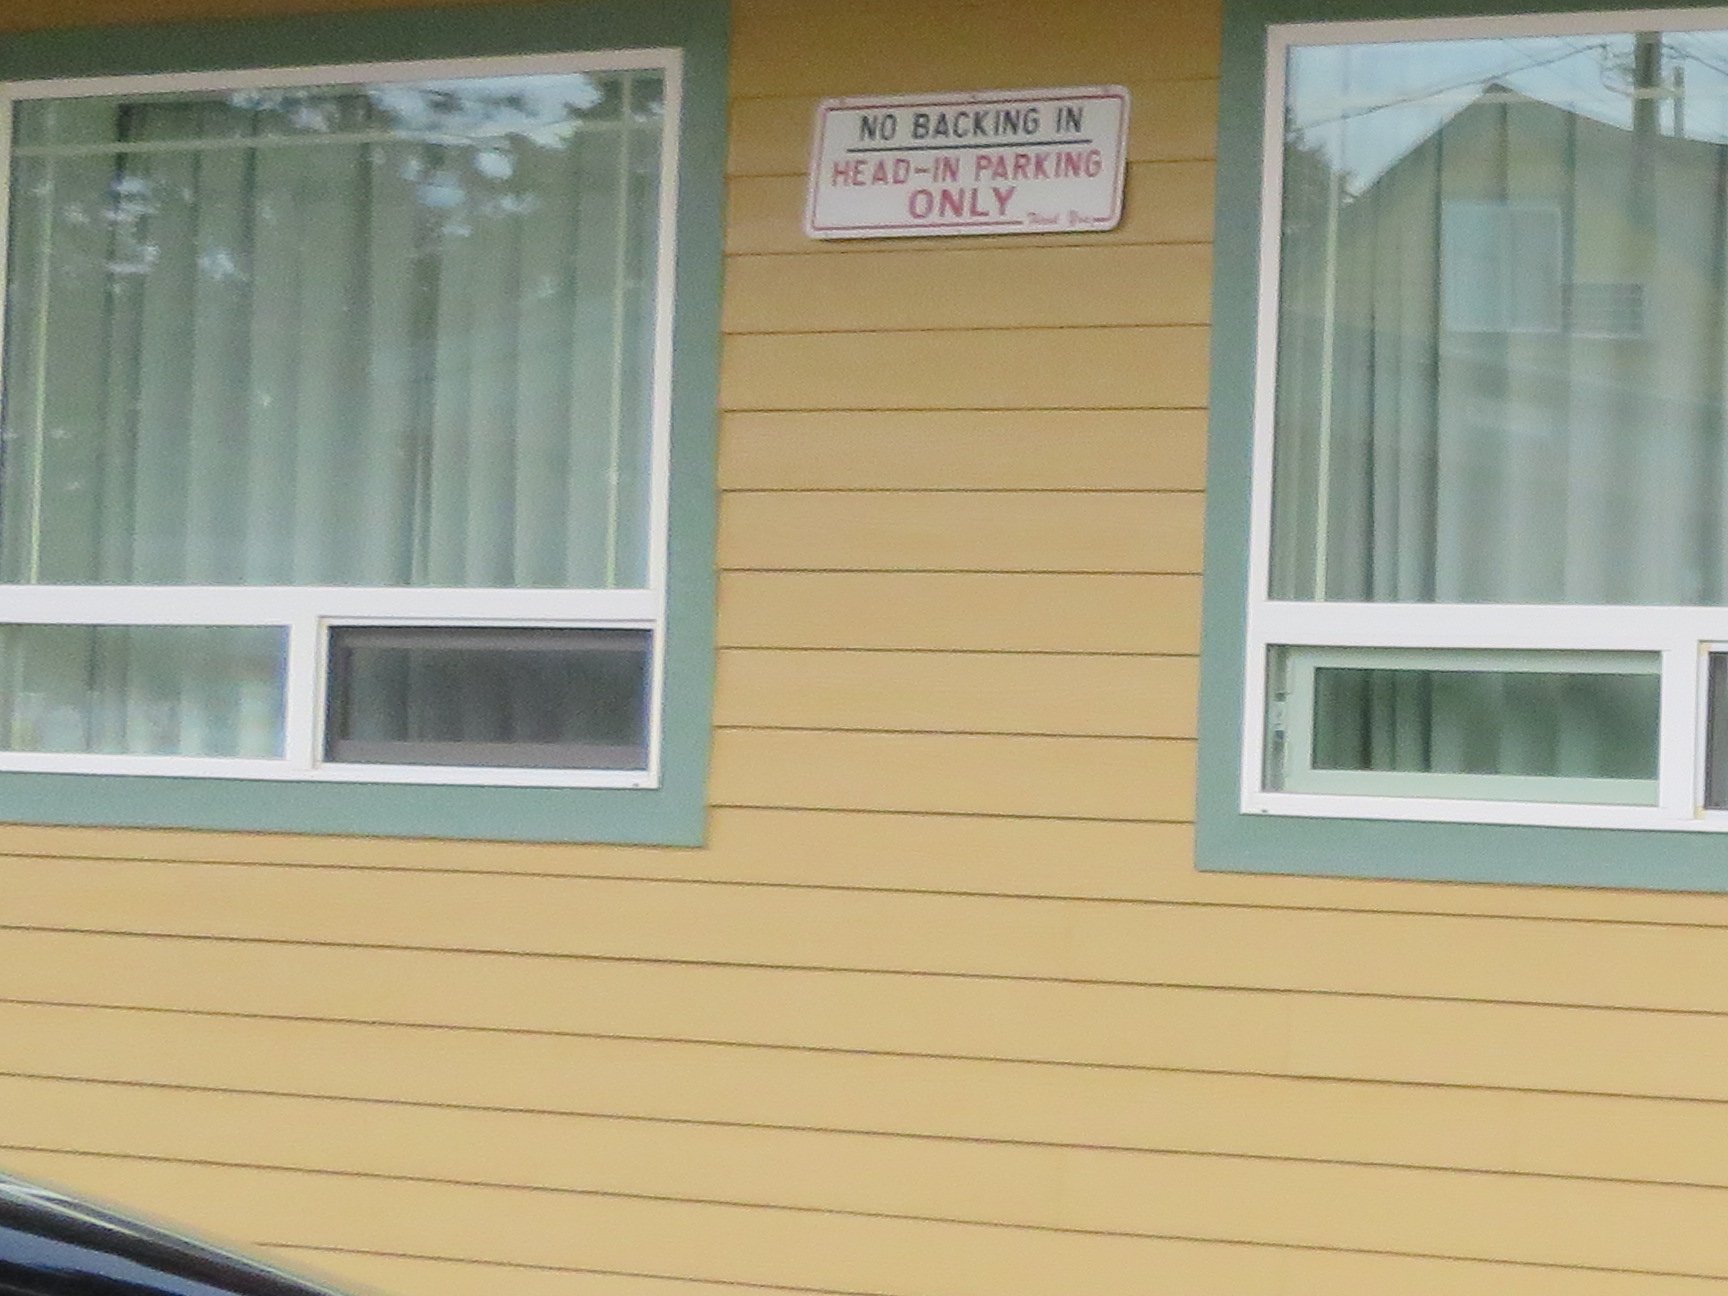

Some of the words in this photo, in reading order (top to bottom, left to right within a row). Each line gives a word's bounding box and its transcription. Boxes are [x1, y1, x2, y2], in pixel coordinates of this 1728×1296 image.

[860, 113, 897, 141] NO
[911, 108, 1040, 139] BACKING
[1055, 106, 1085, 133] IN
[831, 156, 960, 187] HEAD-IN
[975, 149, 1103, 181] PARKING
[908, 186, 1017, 219] ONLY
